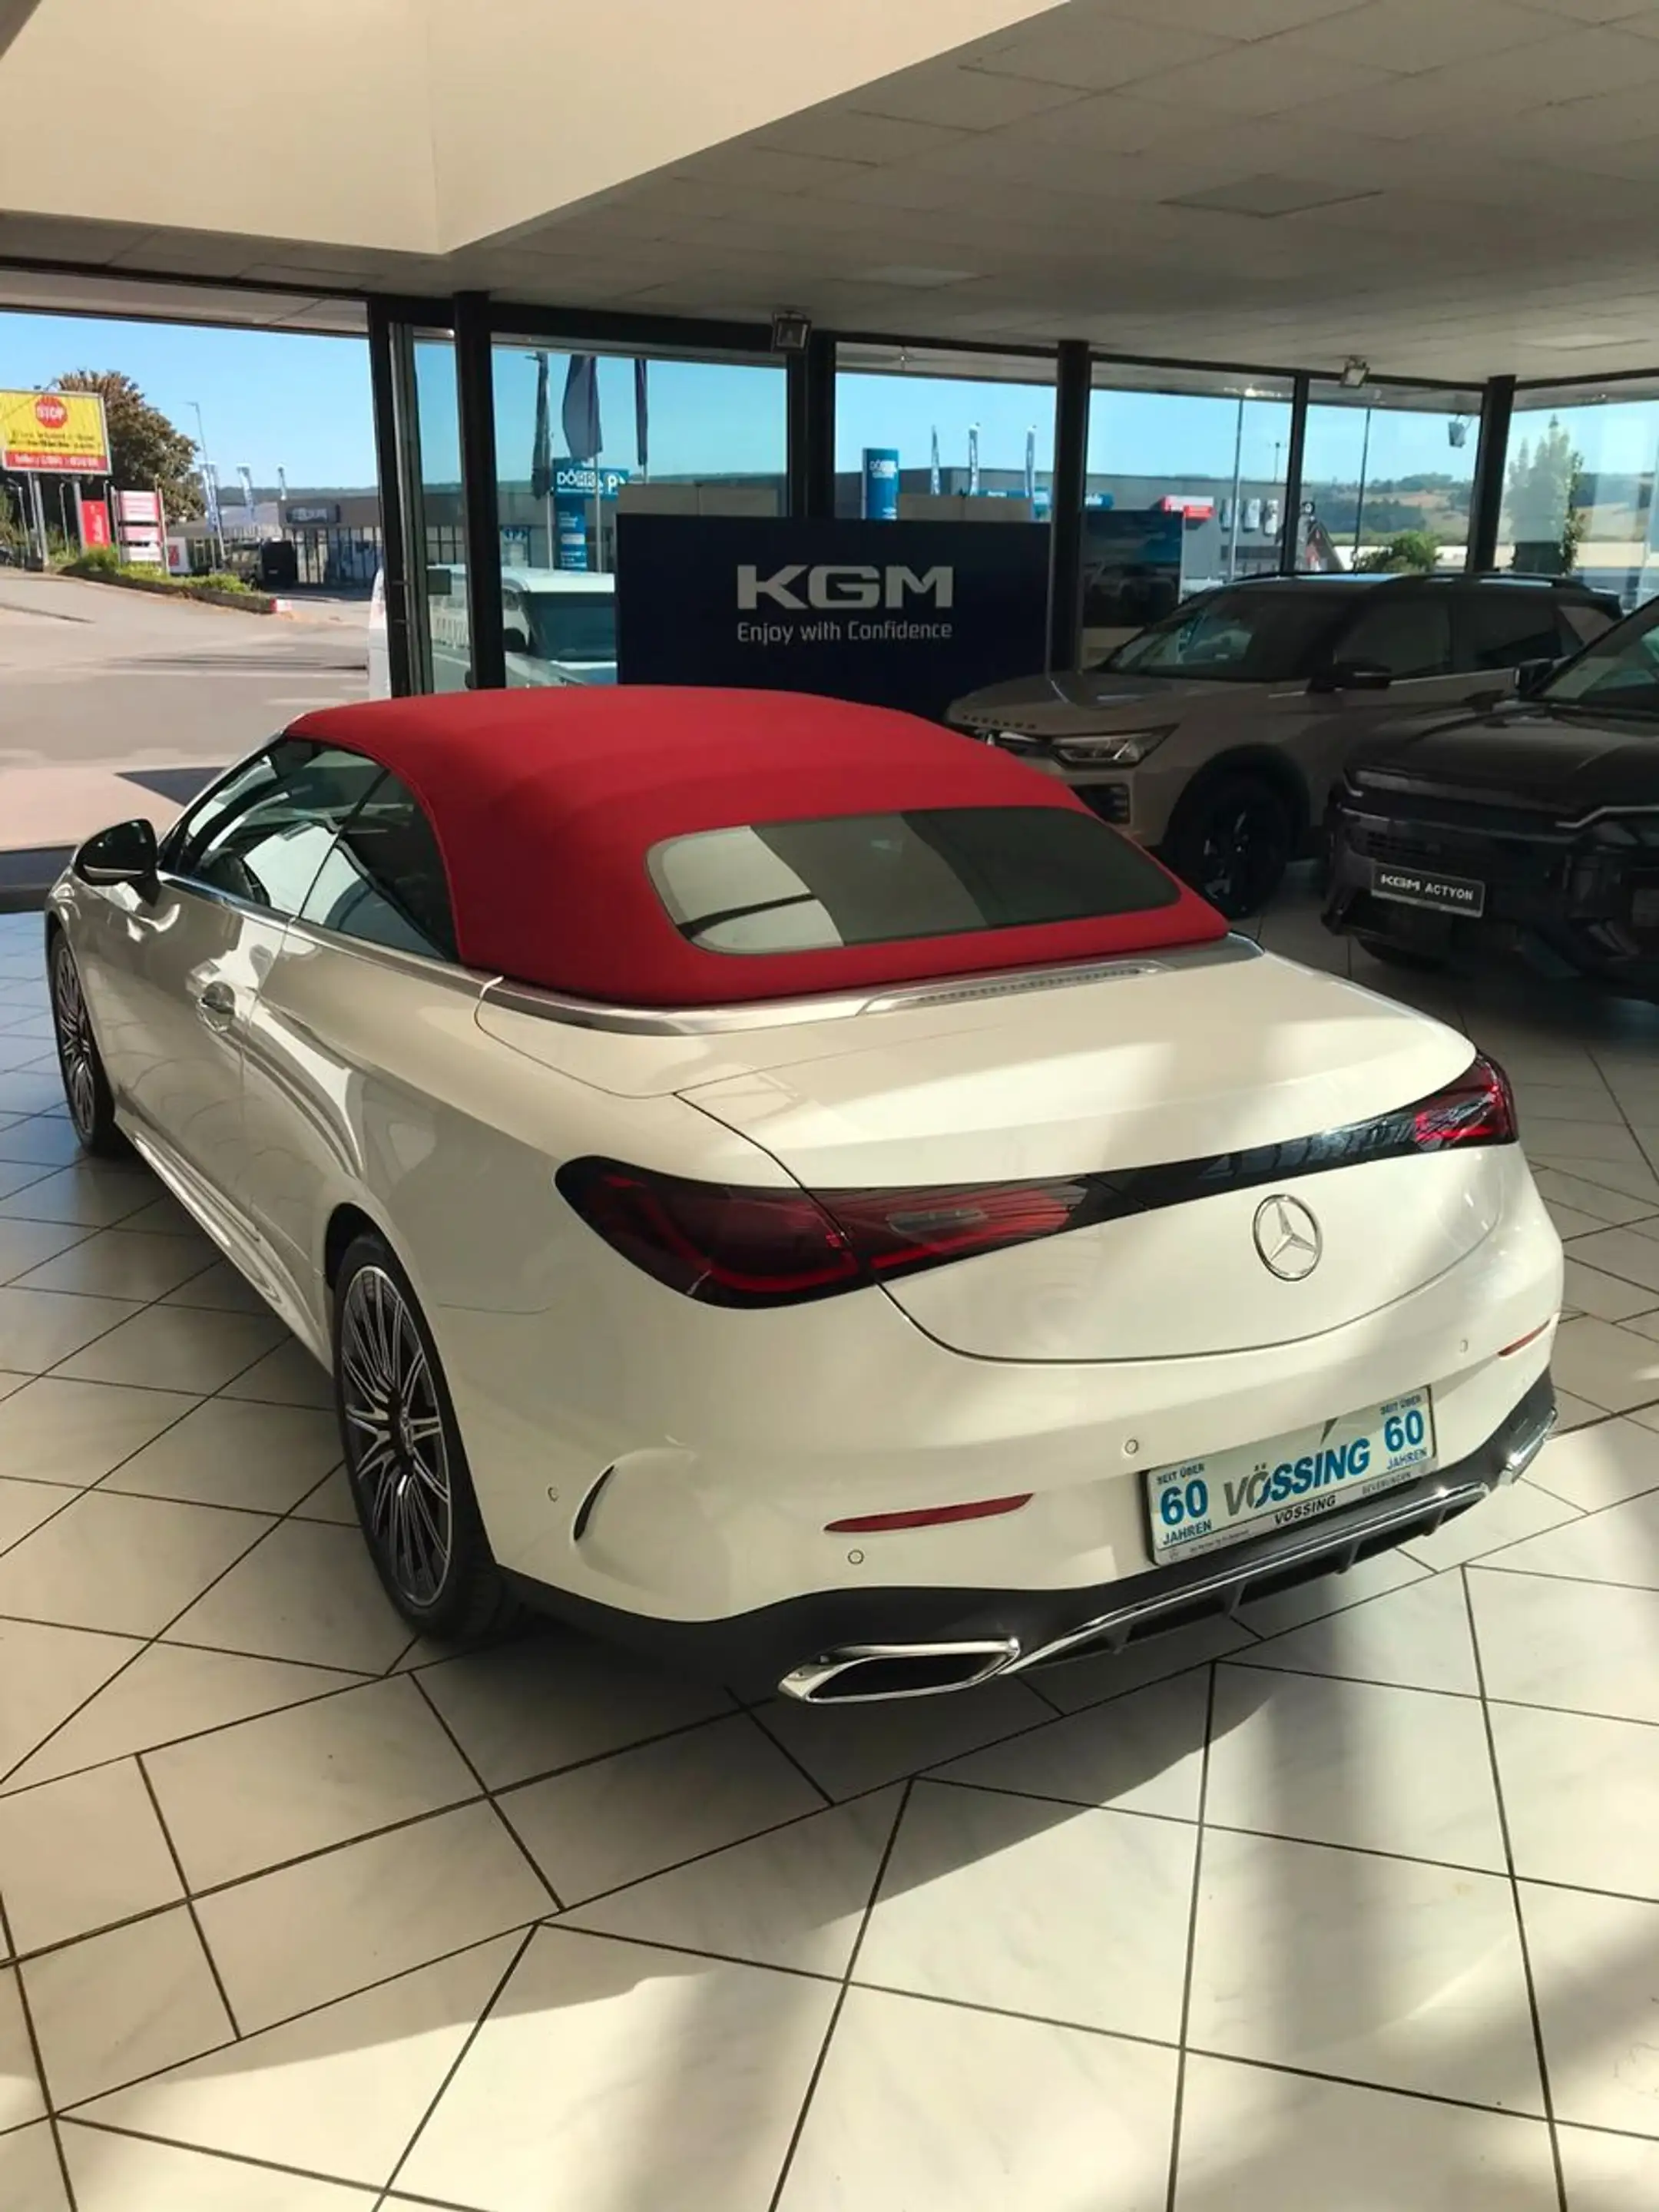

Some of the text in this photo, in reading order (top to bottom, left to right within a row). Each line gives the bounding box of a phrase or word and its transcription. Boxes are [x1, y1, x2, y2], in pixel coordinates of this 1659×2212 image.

[737, 565, 953, 609] KGM
[737, 621, 952, 645] Enjoy with Confidence
[1380, 873, 1474, 900] KGM ACTYON
[1380, 1401, 1399, 1415] SEIT
[1384, 1409, 1424, 1452] 60
[1386, 1446, 1427, 1470] JAHREN
[1156, 1462, 1205, 1485] SEIT ÜBER
[1223, 1437, 1371, 1517] VÖSSING
[1161, 1479, 1209, 1525] 60
[1162, 1518, 1212, 1545] JAHREN
